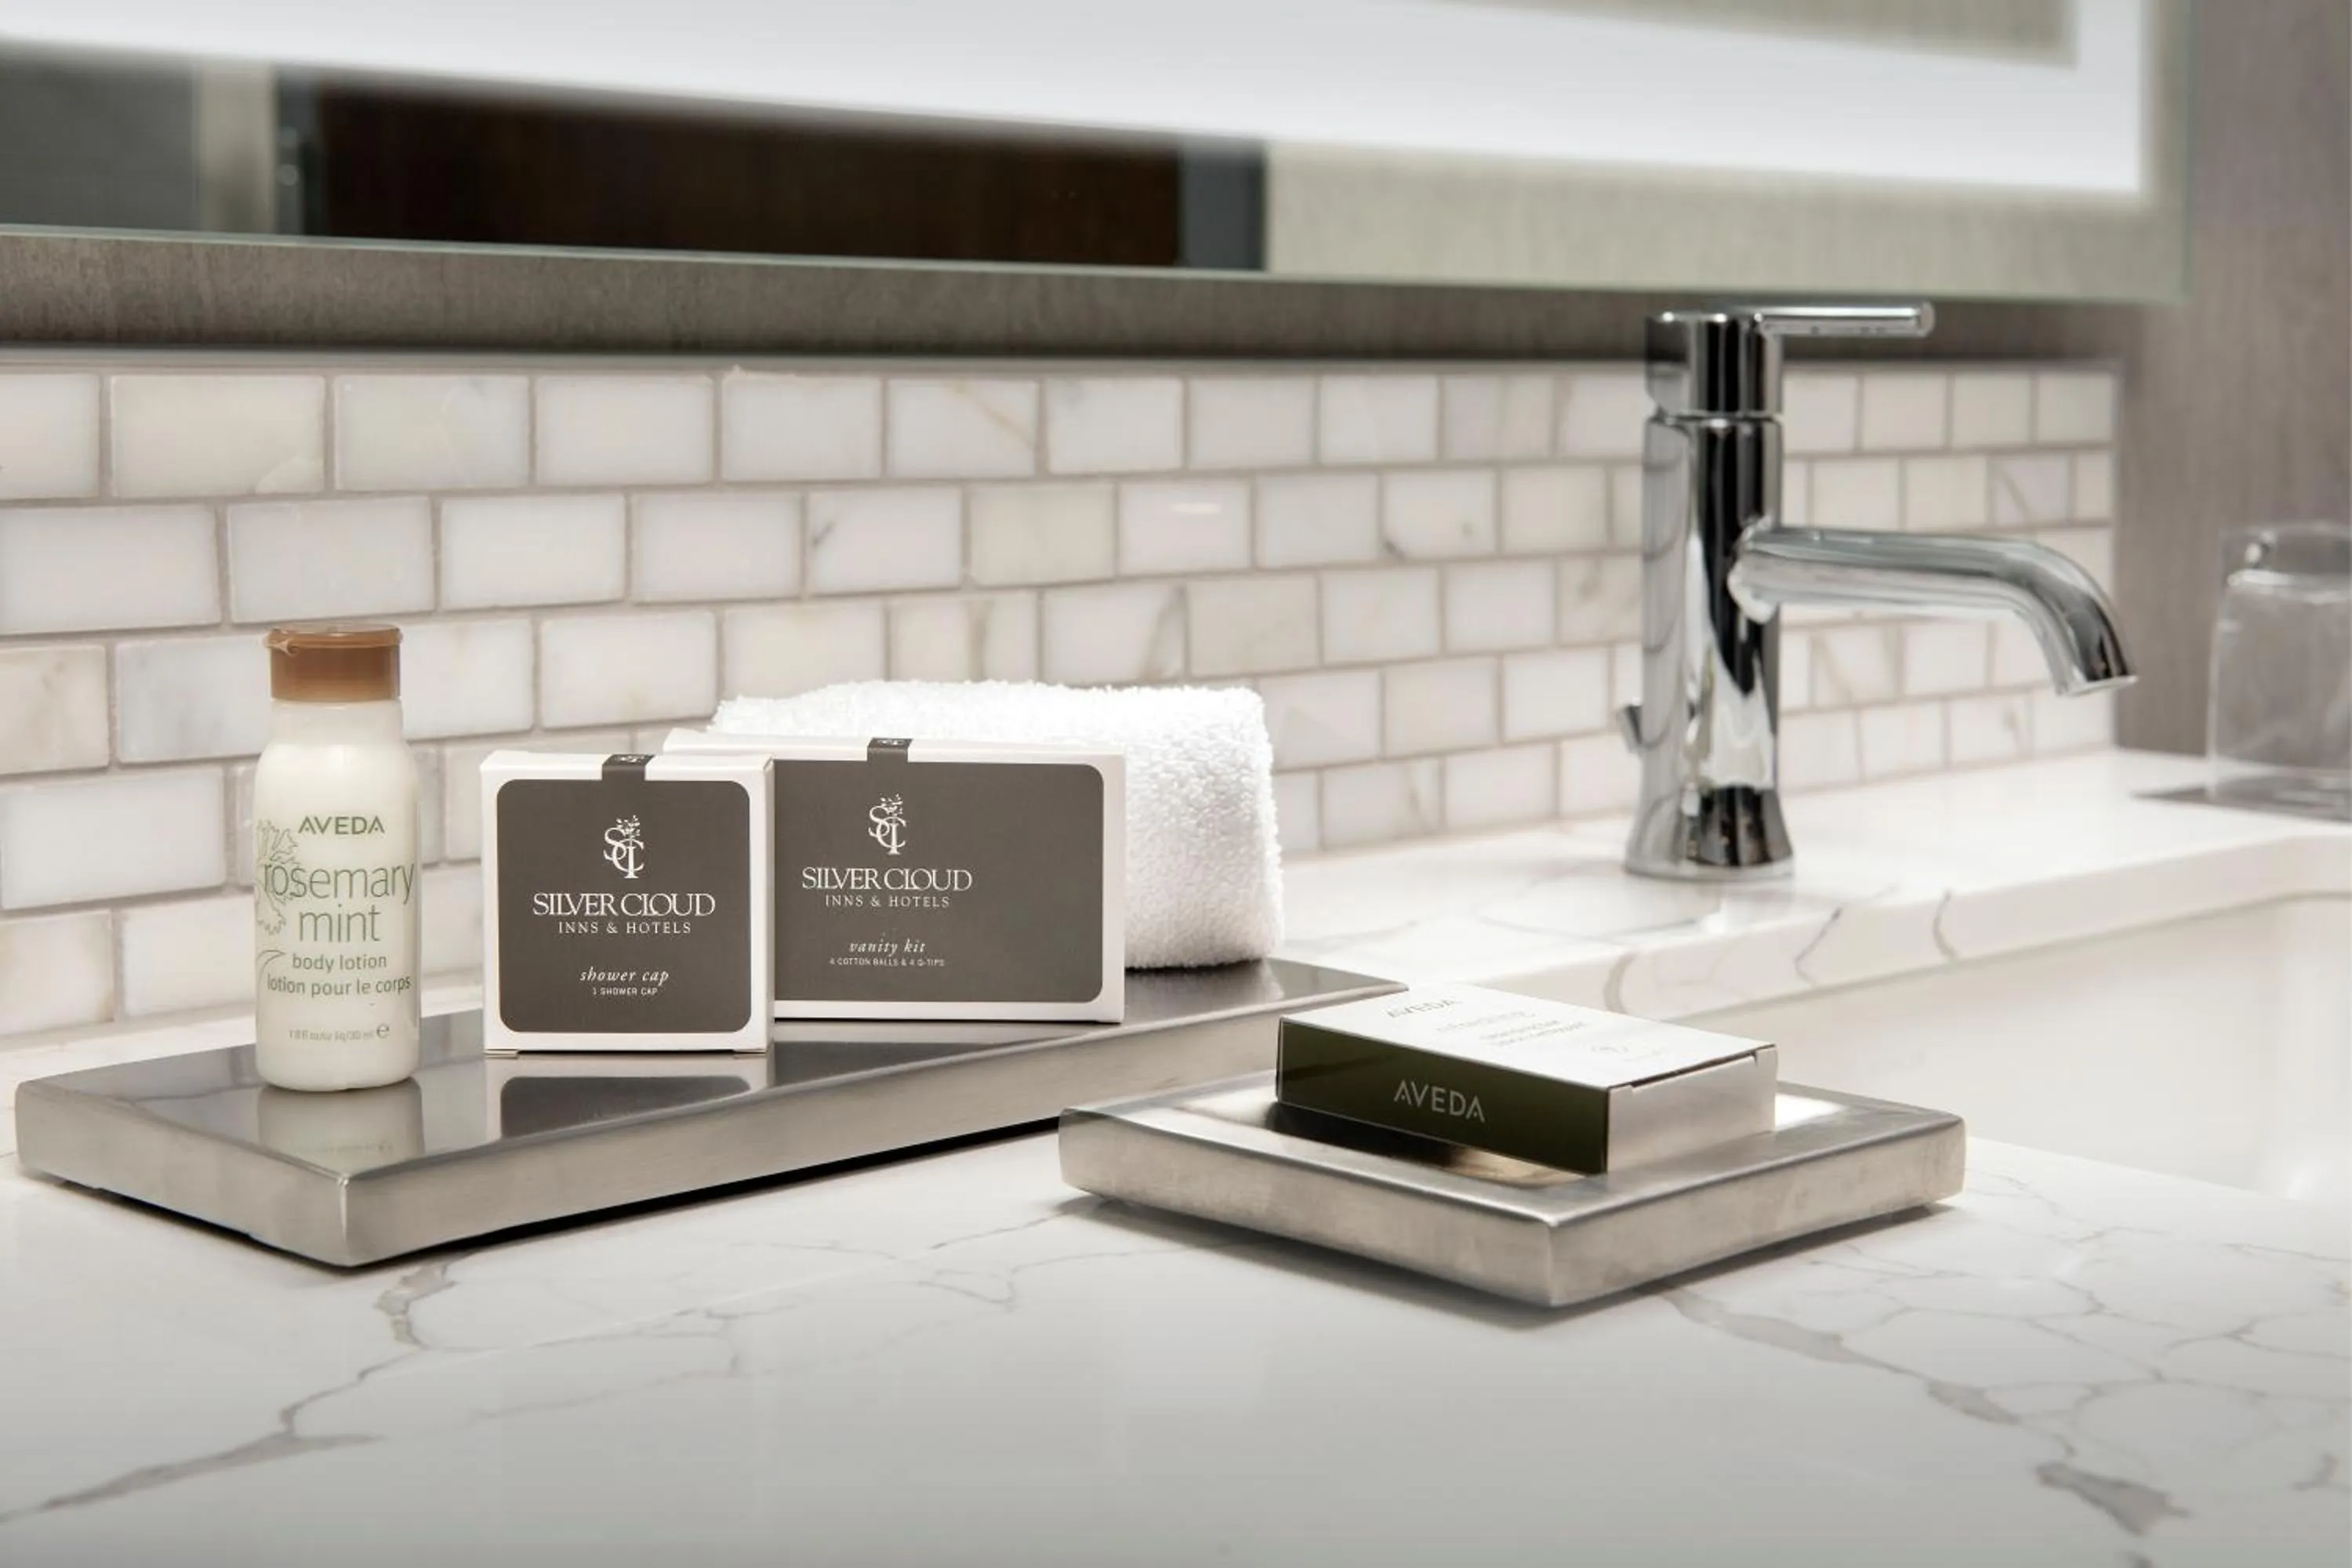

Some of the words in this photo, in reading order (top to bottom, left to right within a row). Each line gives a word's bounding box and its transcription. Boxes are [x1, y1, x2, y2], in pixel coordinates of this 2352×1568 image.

[298, 815, 386, 835] AVEDA
[263, 863, 416, 906] rosemary
[801, 866, 881, 891] SILVER
[884, 867, 974, 892] CLOUD
[532, 892, 618, 917] SILVER
[621, 892, 717, 917] CLOUD
[825, 894, 863, 908] INNS
[871, 895, 881, 907] &
[888, 895, 950, 909] HOTELS
[299, 903, 382, 942] mint
[558, 921, 599, 935] INNS
[606, 922, 619, 935] &
[626, 921, 691, 935] HOTELS
[849, 937, 898, 956] vanity
[904, 938, 926, 953] kit
[292, 953, 335, 973] body
[339, 953, 387, 971] lotion
[837, 956, 871, 966] COTTON
[873, 957, 899, 967] BALLS
[916, 958, 946, 967] Q-TIPS
[267, 972, 306, 995] lotion
[311, 982, 352, 998] pour
[356, 978, 372, 995] le
[376, 975, 412, 995] corps
[579, 966, 637, 983] shower
[641, 971, 670, 986] cap
[600, 987, 638, 996] SHOWER
[641, 987, 659, 996] CAP
[1393, 1078, 1486, 1124] AVEDA
